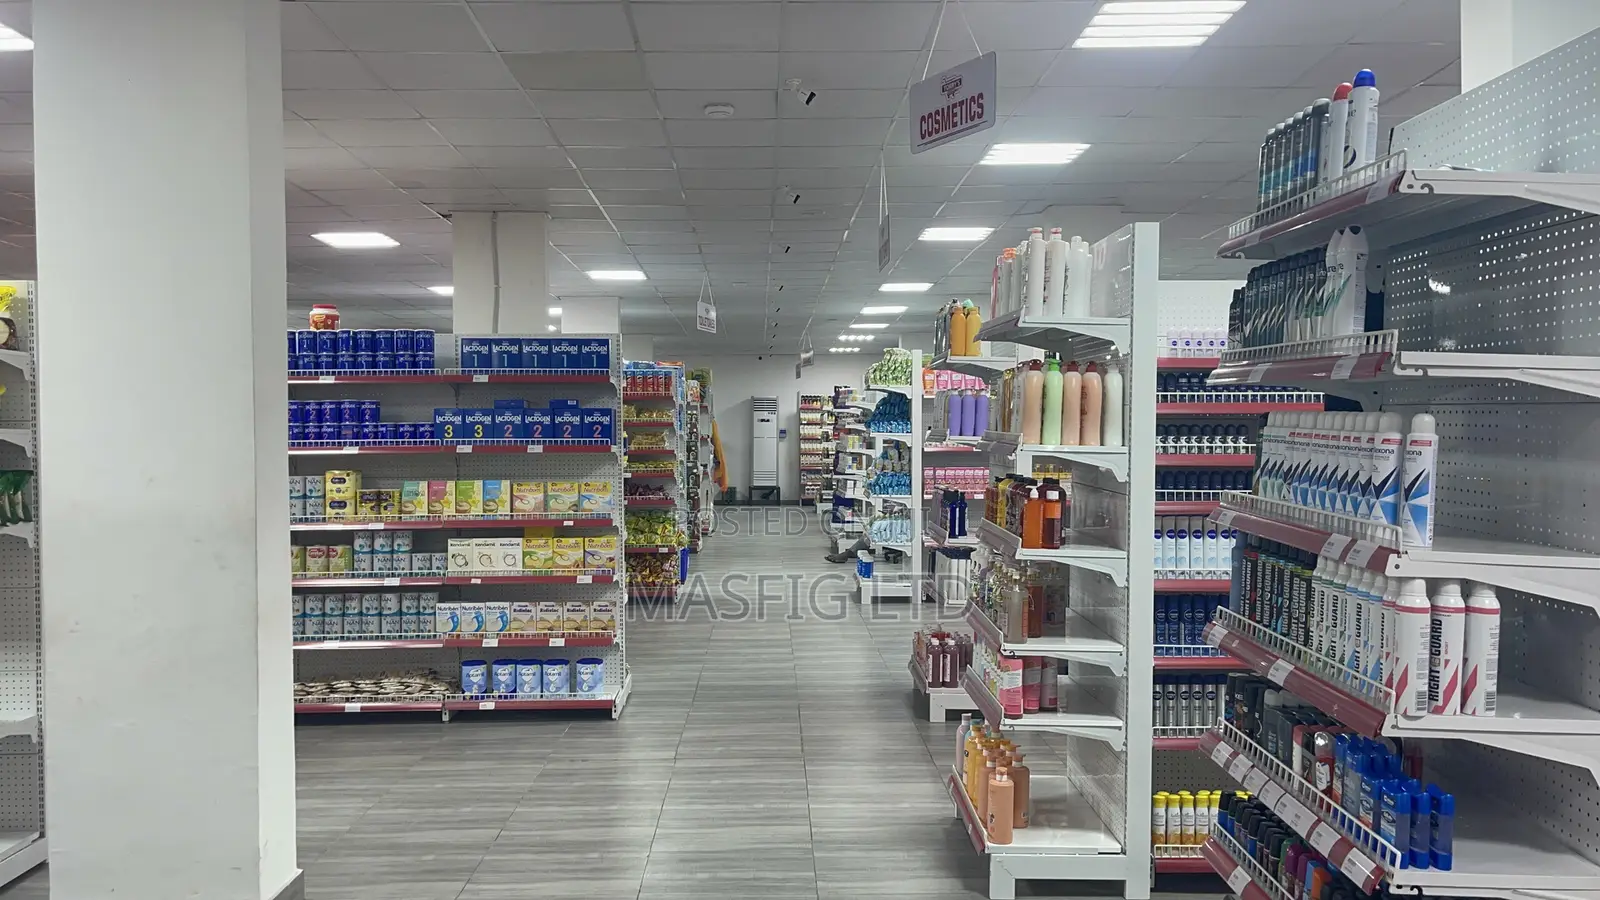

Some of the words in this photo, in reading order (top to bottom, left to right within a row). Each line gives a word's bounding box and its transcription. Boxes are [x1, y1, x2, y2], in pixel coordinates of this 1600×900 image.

[920, 92, 984, 140] COSMETICS
[463, 344, 489, 353] LACTOGEN
[492, 344, 518, 353] LACTOGEN
[523, 344, 549, 353] LACTOGEN
[552, 344, 578, 353] LACTOGEN
[582, 344, 608, 353] LACTOGEN
[472, 354, 477, 367] 1
[502, 354, 507, 367] 1
[533, 354, 537, 367] 1
[562, 354, 566, 367] 1
[592, 354, 596, 367] 1
[436, 415, 462, 423] LACTOGEN
[466, 415, 491, 423] LACTOGEN
[496, 415, 521, 423] LACTOGEN
[525, 415, 551, 423] LACTOGEN
[554, 415, 580, 423] LACTOGEN
[584, 415, 610, 423] LACTOGEN
[444, 425, 453, 438] 3
[474, 425, 483, 438] 3
[504, 425, 512, 438] 2
[533, 425, 542, 438] 2
[563, 425, 571, 438] 2
[593, 425, 602, 438] 2
[1432, 619, 1442, 656] GUARD
[1428, 667, 1441, 702] RIGHT
